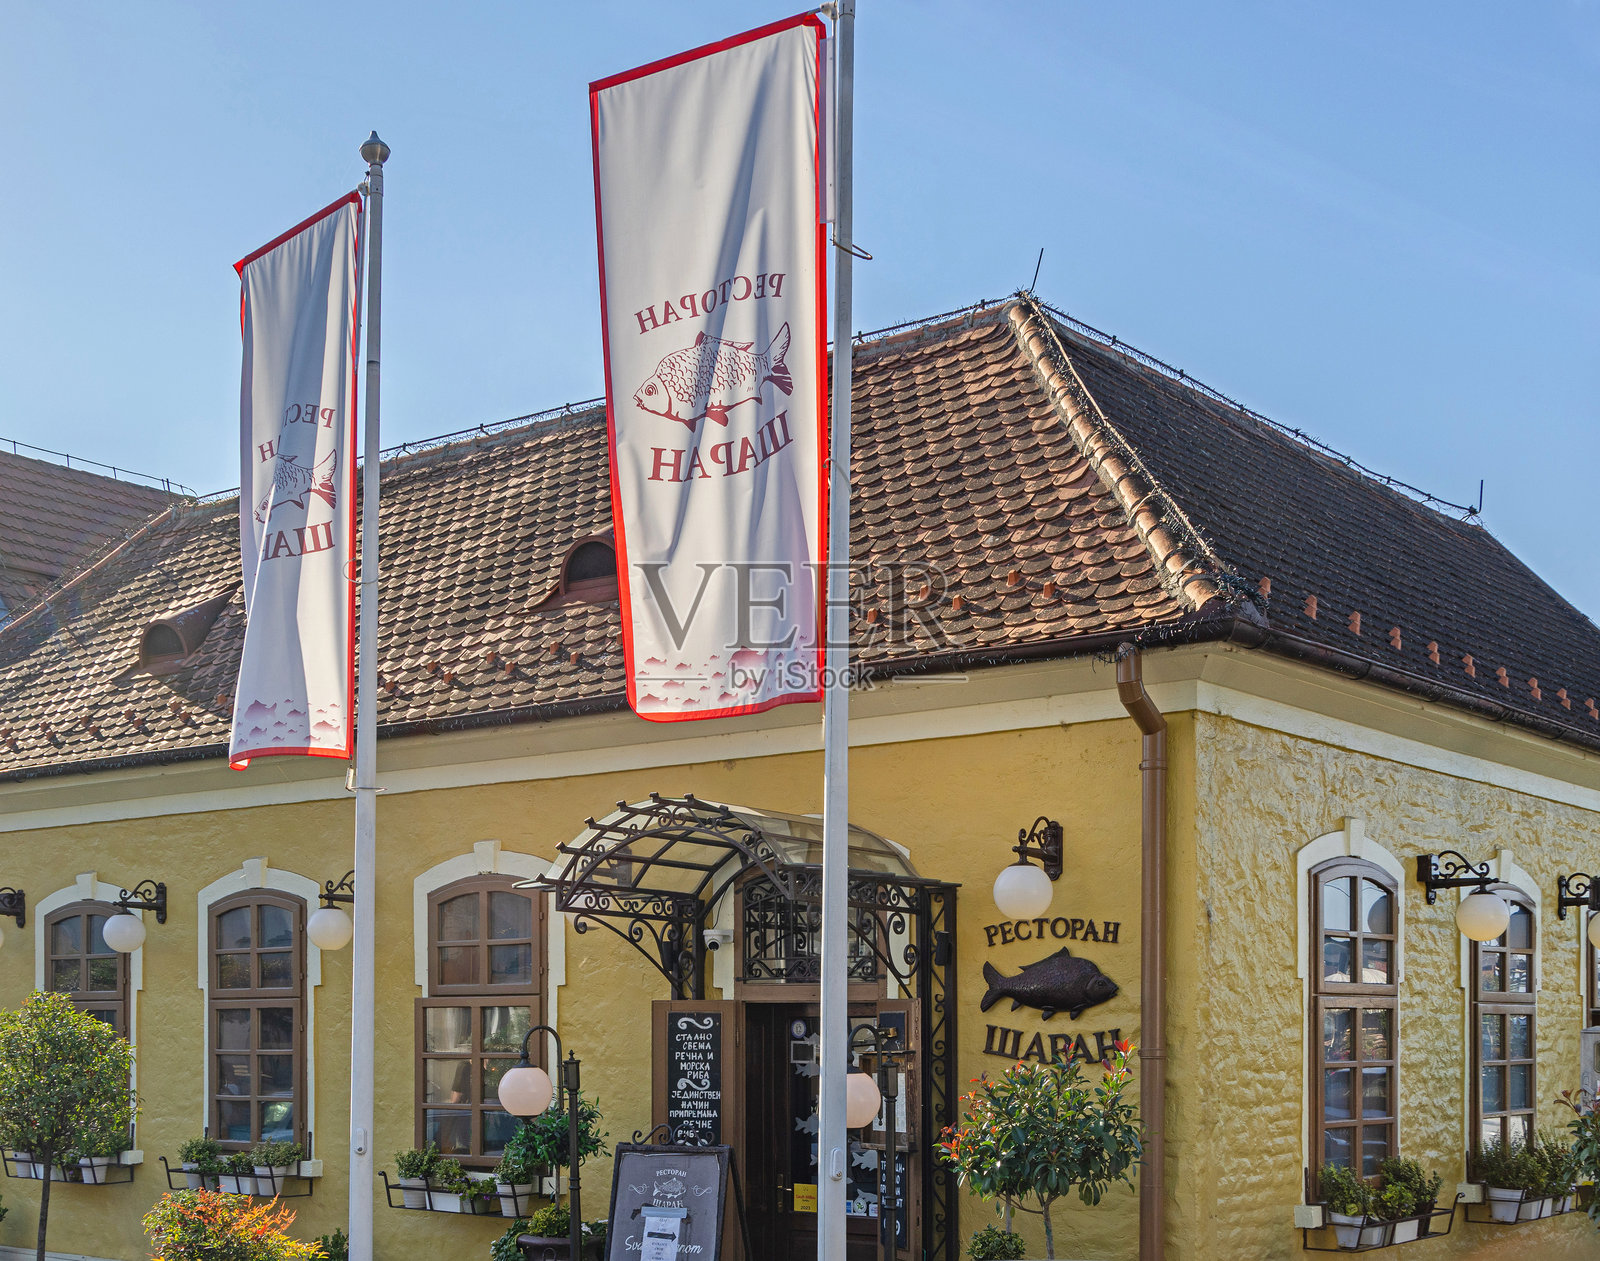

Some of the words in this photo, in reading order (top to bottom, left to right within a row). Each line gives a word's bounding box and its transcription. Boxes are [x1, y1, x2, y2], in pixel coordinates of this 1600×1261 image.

[984, 916, 1121, 947] РЕСТОРАН
[982, 1024, 1122, 1065] ШАРАН
[675, 1051, 704, 1060] РЕЧНА
[707, 1051, 714, 1060] И
[680, 1061, 711, 1071] МОРСКА
[687, 1070, 710, 1079] РИБА
[681, 1100, 710, 1110] НАЧИН
